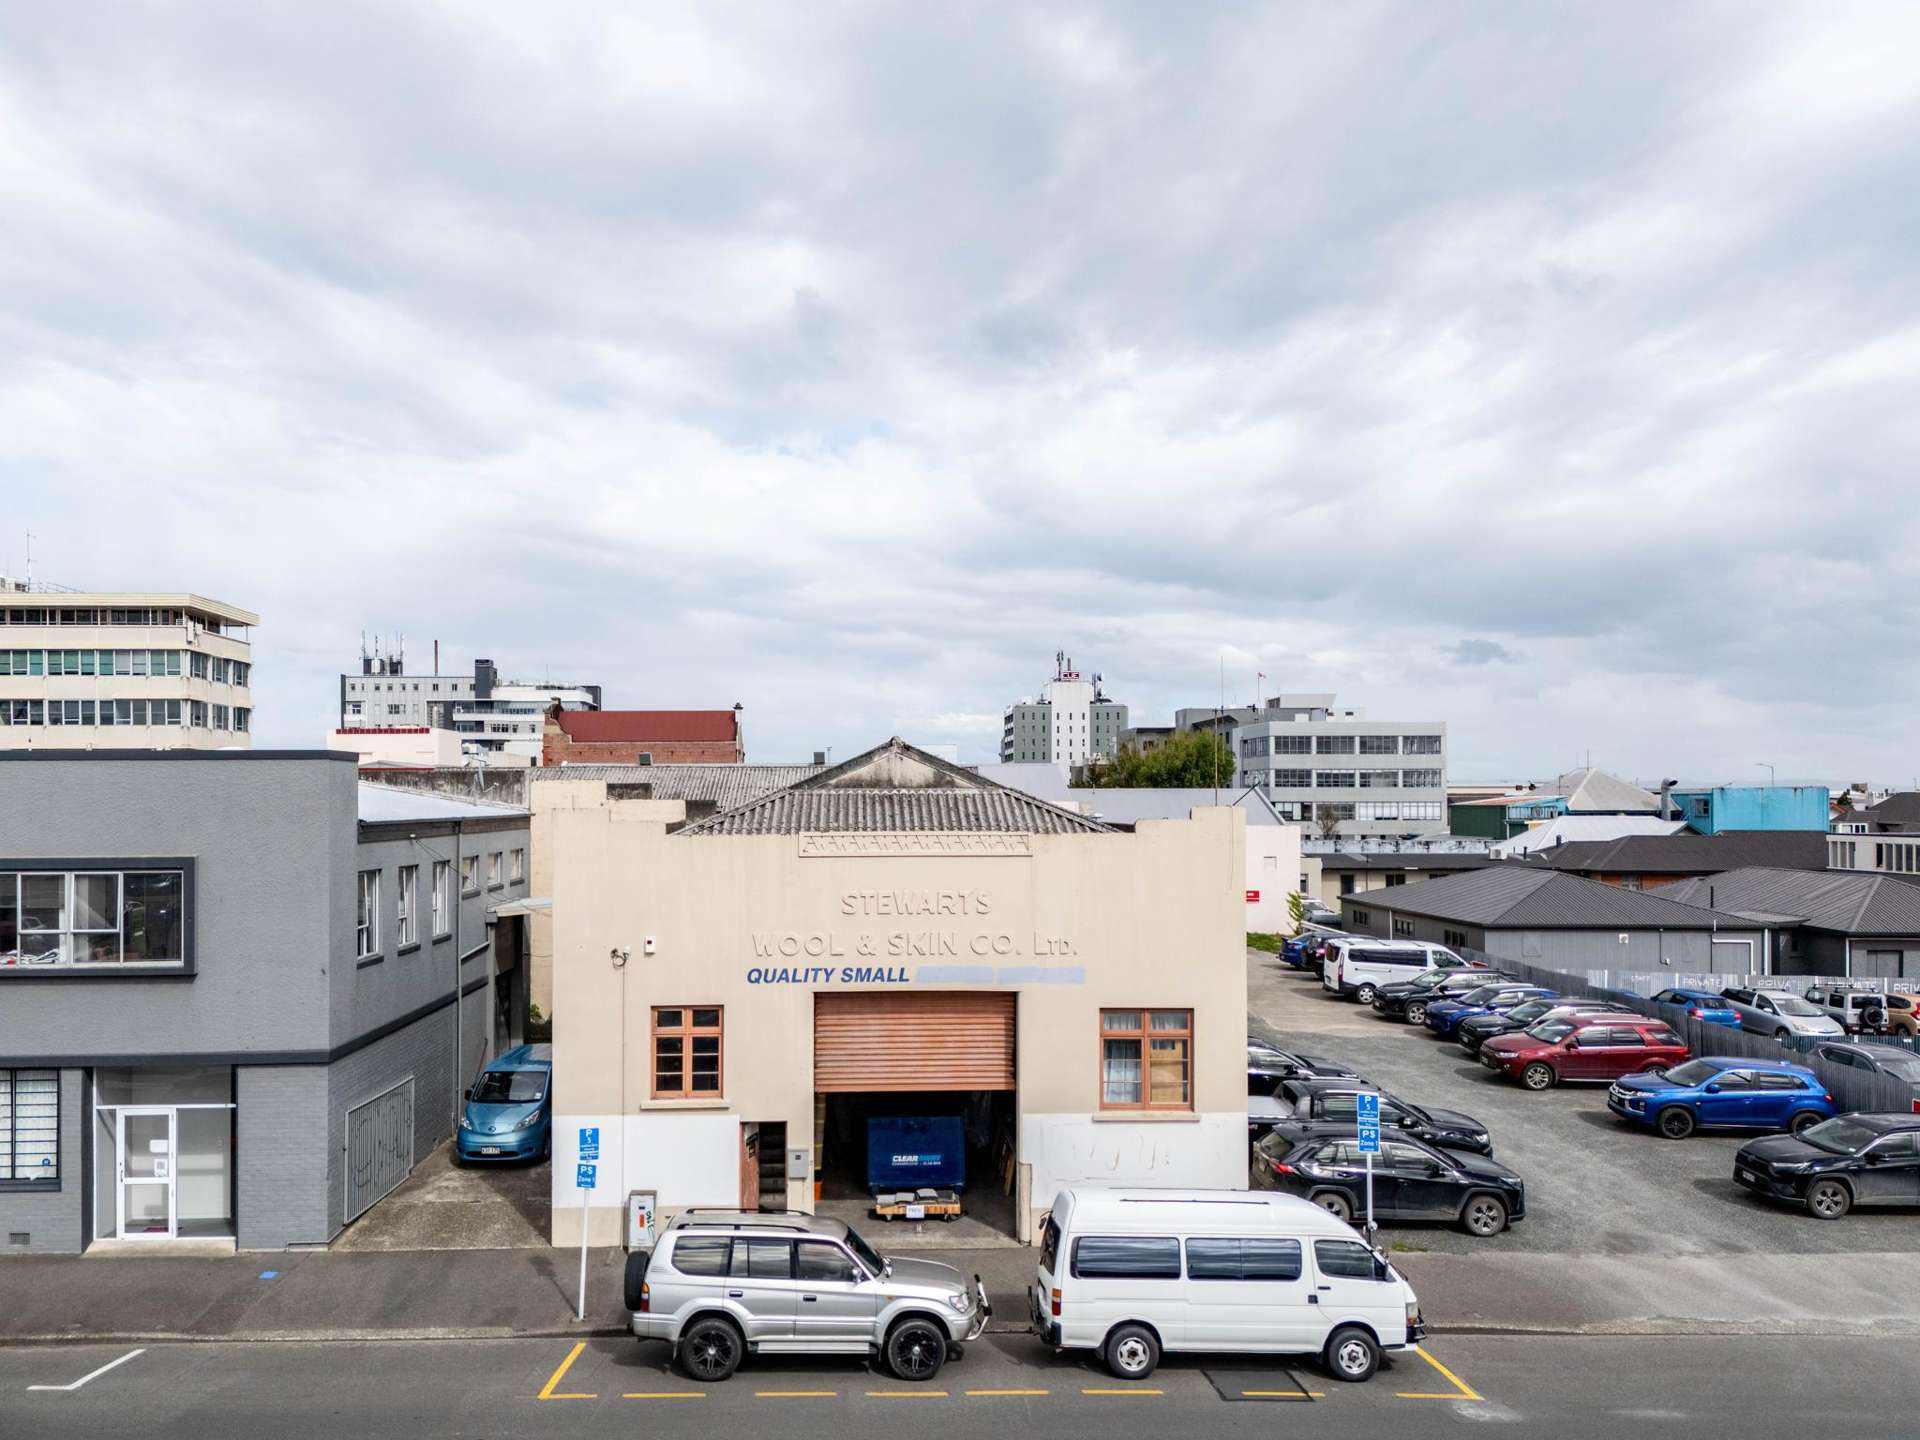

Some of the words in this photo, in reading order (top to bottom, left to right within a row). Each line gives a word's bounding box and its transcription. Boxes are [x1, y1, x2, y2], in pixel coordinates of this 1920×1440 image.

[751, 931, 845, 957] WOOL
[856, 933, 877, 957] &
[887, 931, 958, 956] SKIN
[969, 932, 1022, 956] CO.
[747, 967, 836, 984] QUALITY
[841, 967, 910, 983] SMALL
[1364, 1095, 1372, 1104] P
[585, 1129, 593, 1137] P
